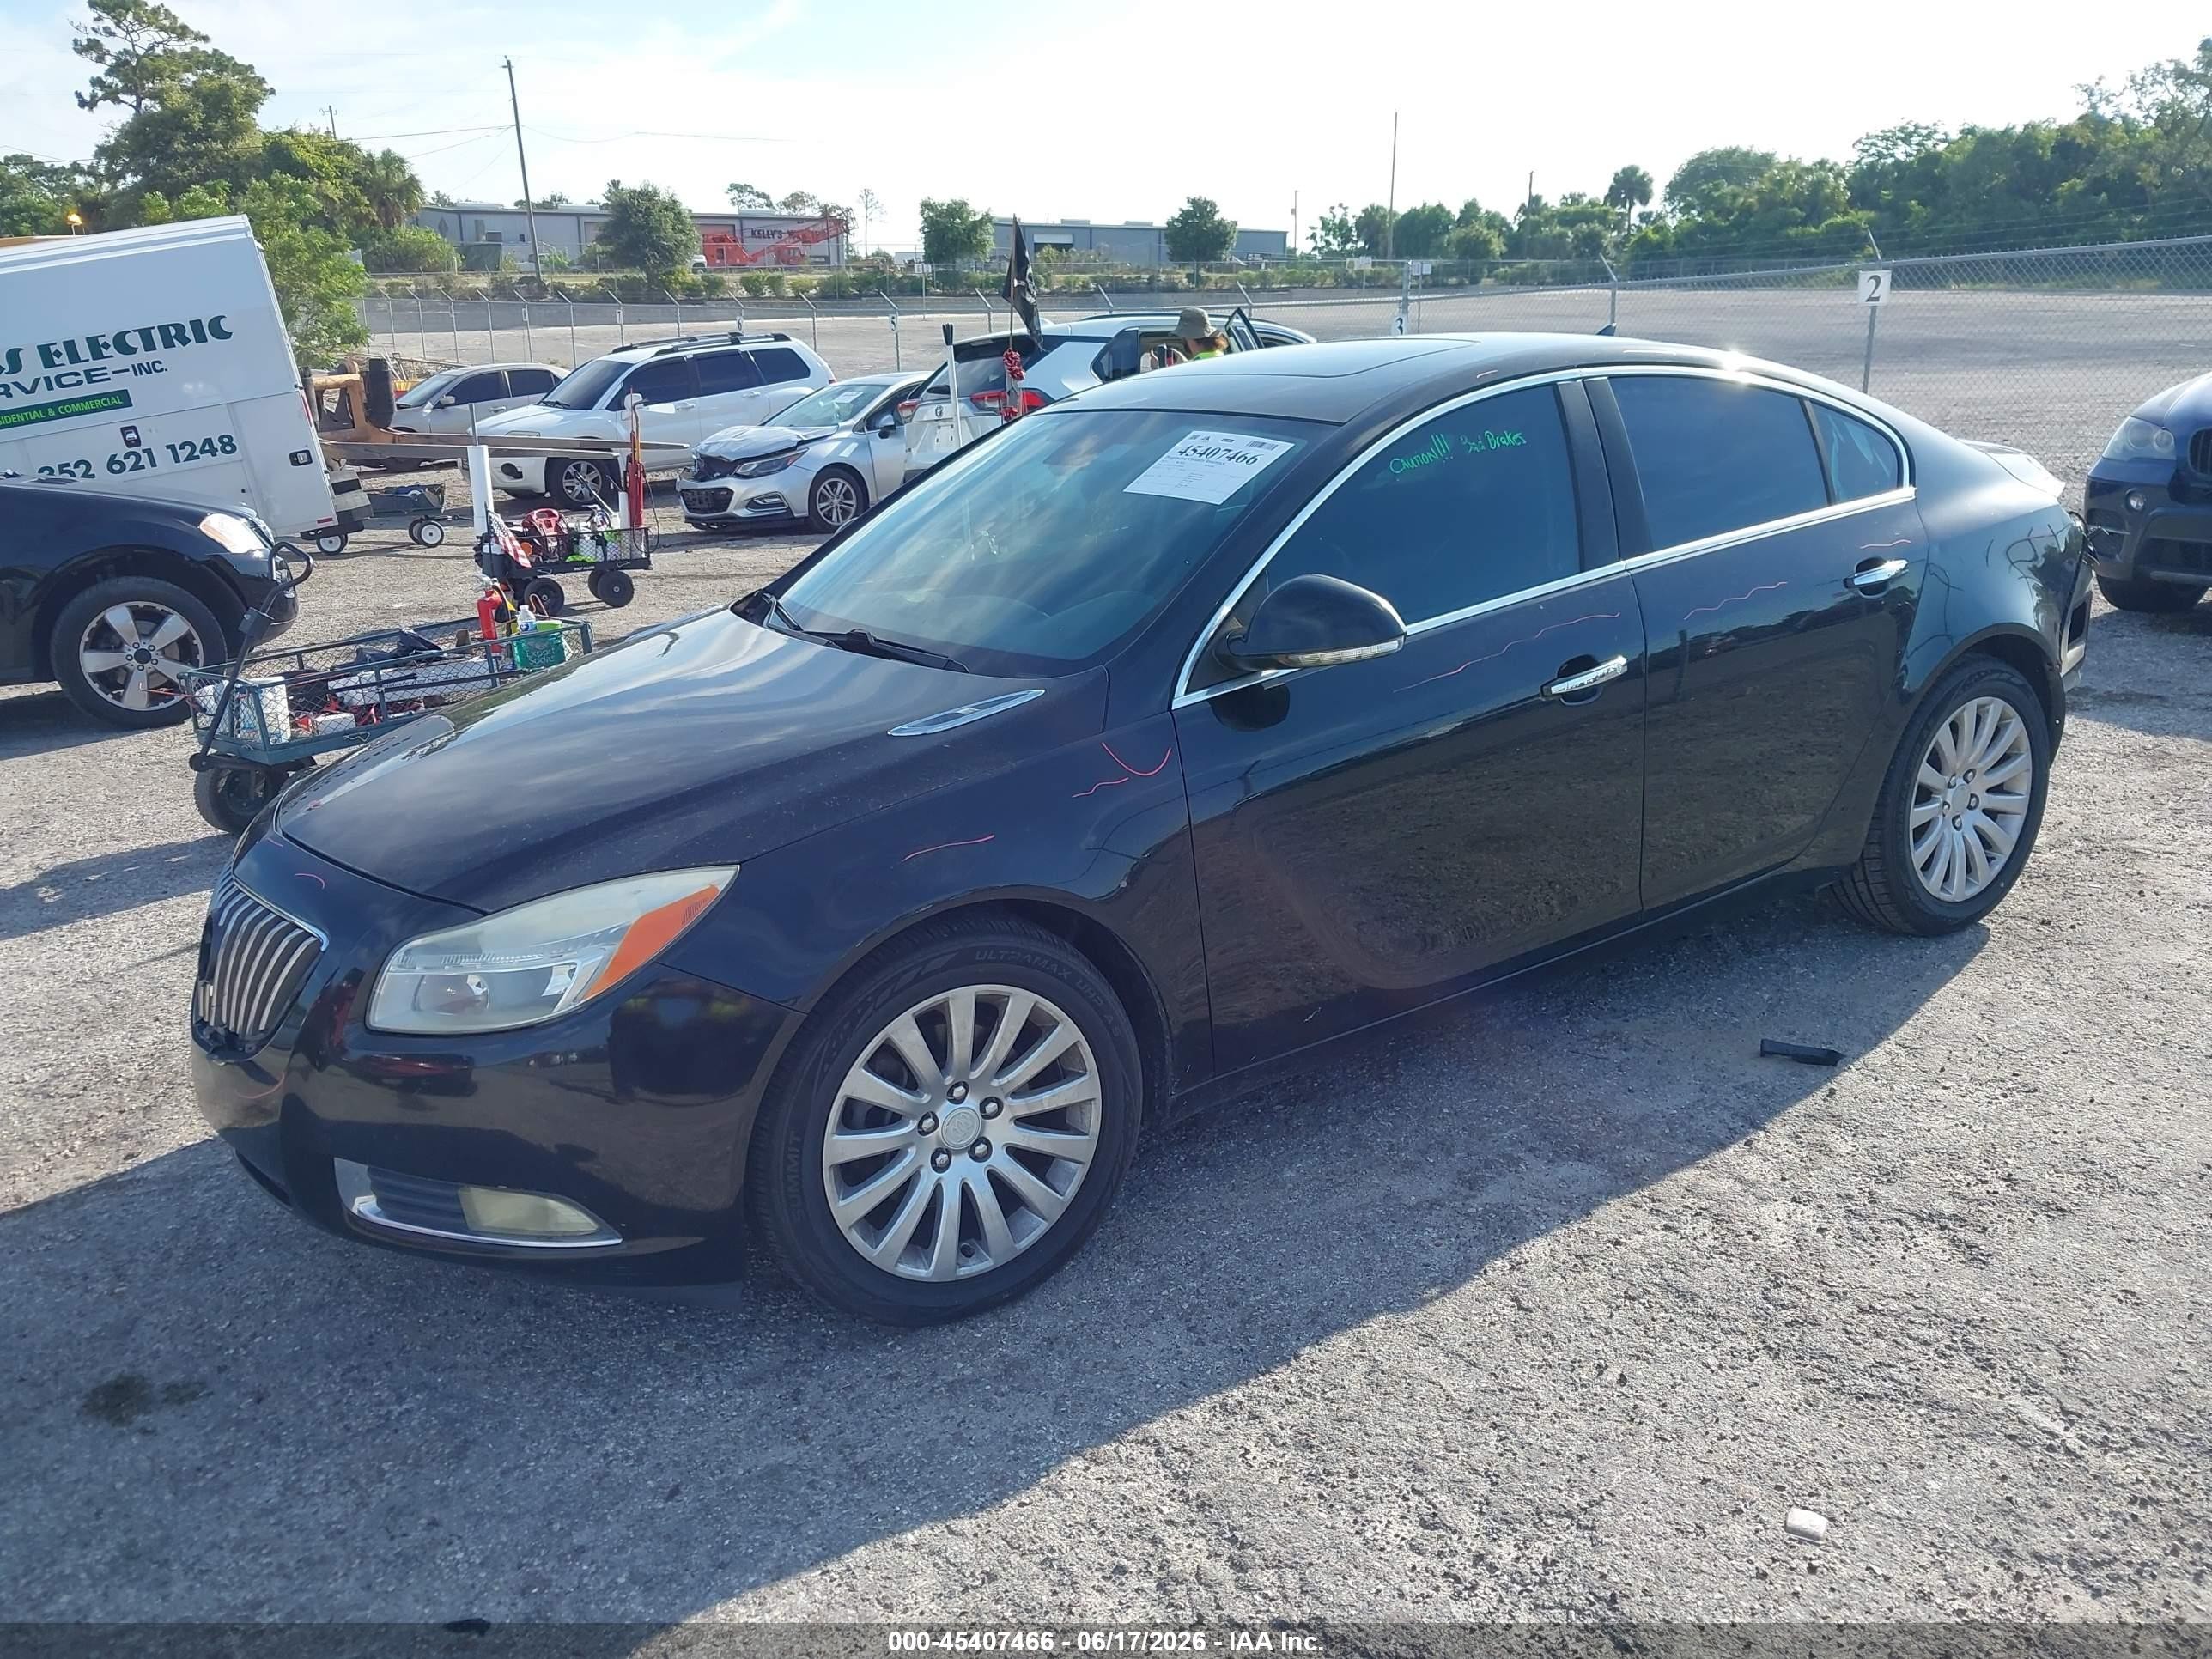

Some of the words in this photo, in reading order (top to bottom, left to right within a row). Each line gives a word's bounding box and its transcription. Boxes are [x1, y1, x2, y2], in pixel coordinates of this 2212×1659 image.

[1865, 275, 1881, 302] 2
[890, 315, 896, 331] 5
[1395, 317, 1404, 336] 3
[0, 347, 24, 375] S
[37, 314, 233, 369] ELECTRIC
[47, 407, 56, 417] &
[58, 395, 124, 415] COMMERCIAL
[106, 447, 157, 475] 621
[166, 434, 237, 464] 1248
[1178, 444, 1263, 465] 45407466
[975, 950, 1073, 981] ULTRAMAX
